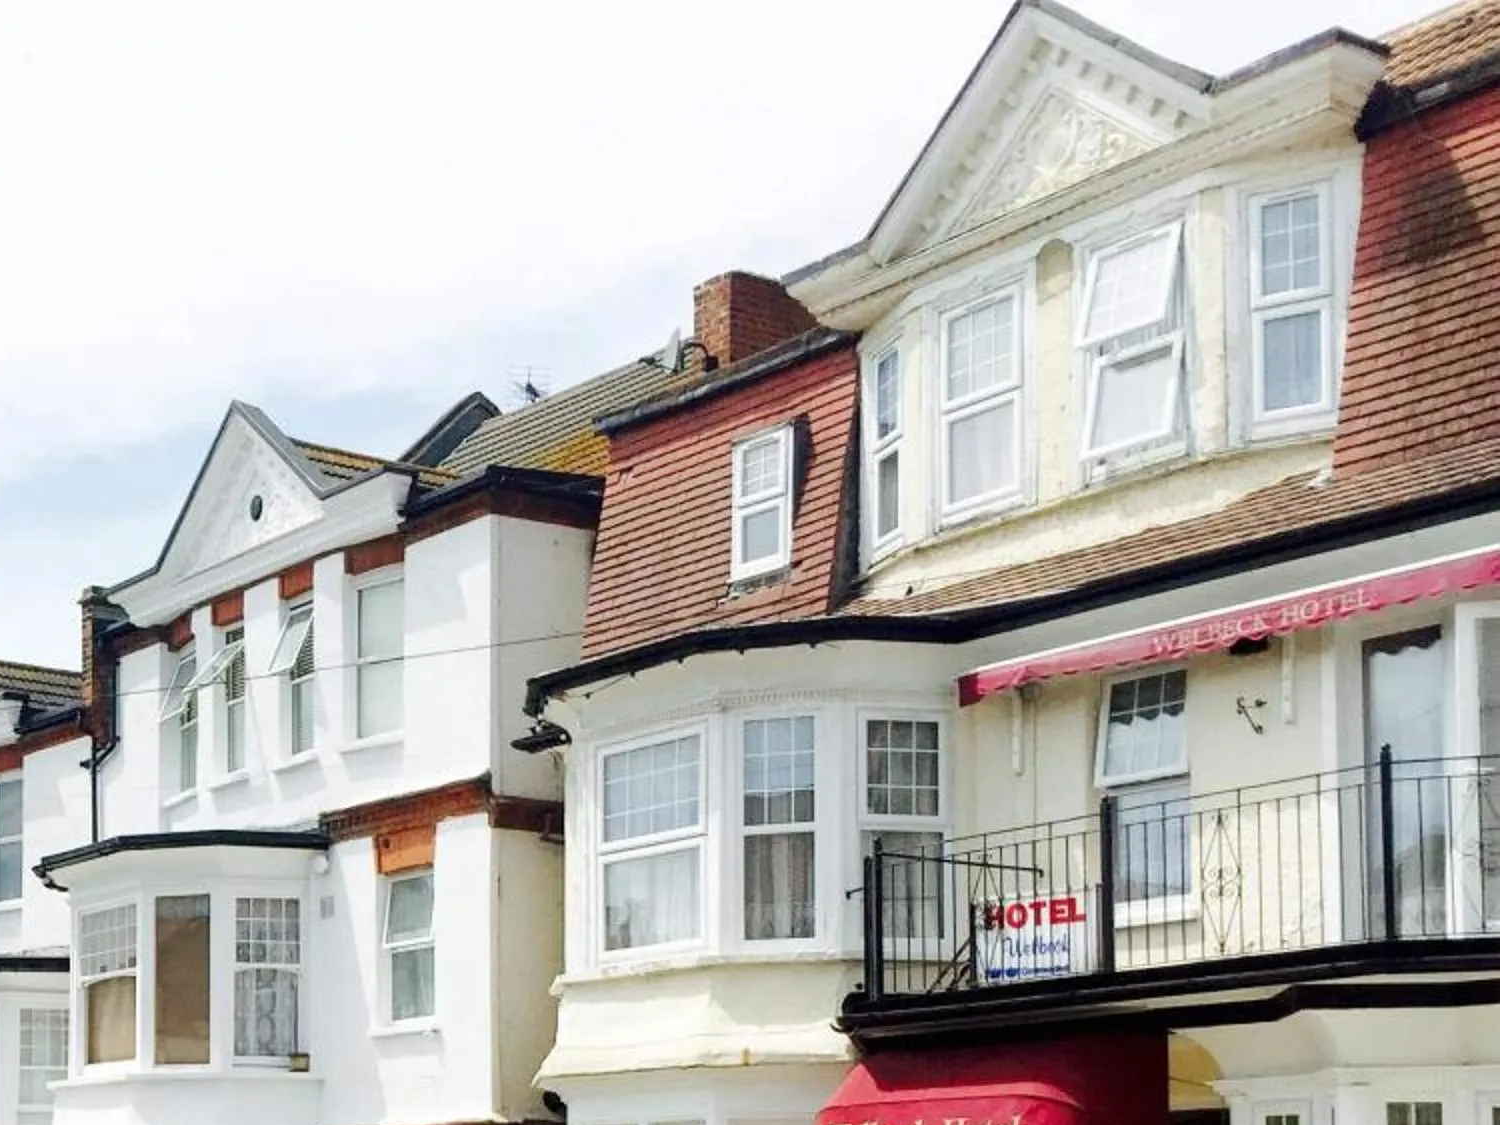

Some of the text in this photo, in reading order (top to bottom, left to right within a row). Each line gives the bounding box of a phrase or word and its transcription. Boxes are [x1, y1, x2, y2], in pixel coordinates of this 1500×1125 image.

[1153, 587, 1372, 653] WELBECK HOTEL
[984, 898, 1086, 930] HOTEL
